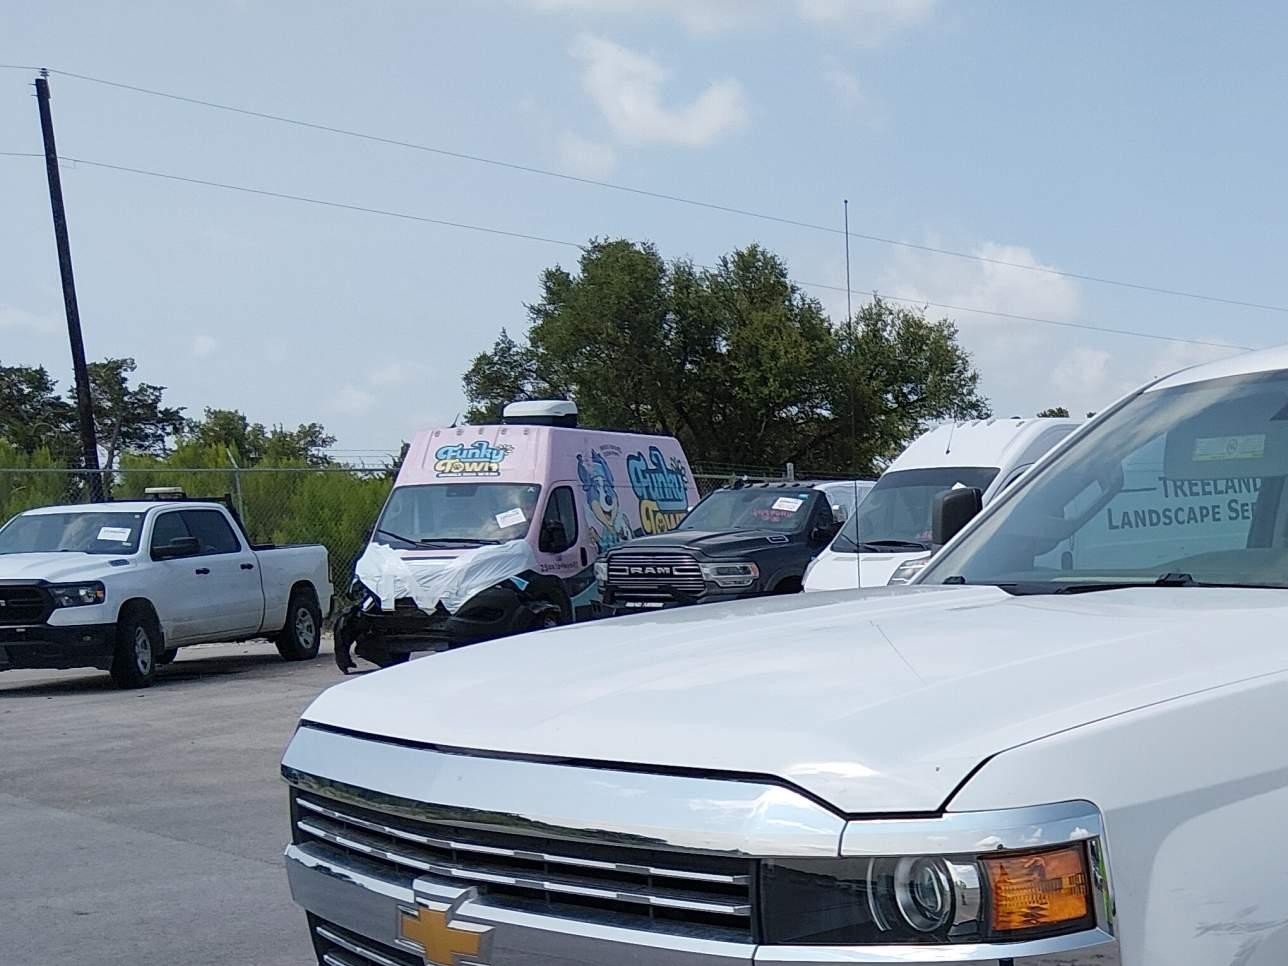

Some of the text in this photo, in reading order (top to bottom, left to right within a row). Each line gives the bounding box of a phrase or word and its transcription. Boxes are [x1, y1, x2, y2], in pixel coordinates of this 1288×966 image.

[435, 441, 504, 462] Funky
[627, 446, 688, 512] Funky
[1107, 505, 1222, 530] LANDSCAPE
